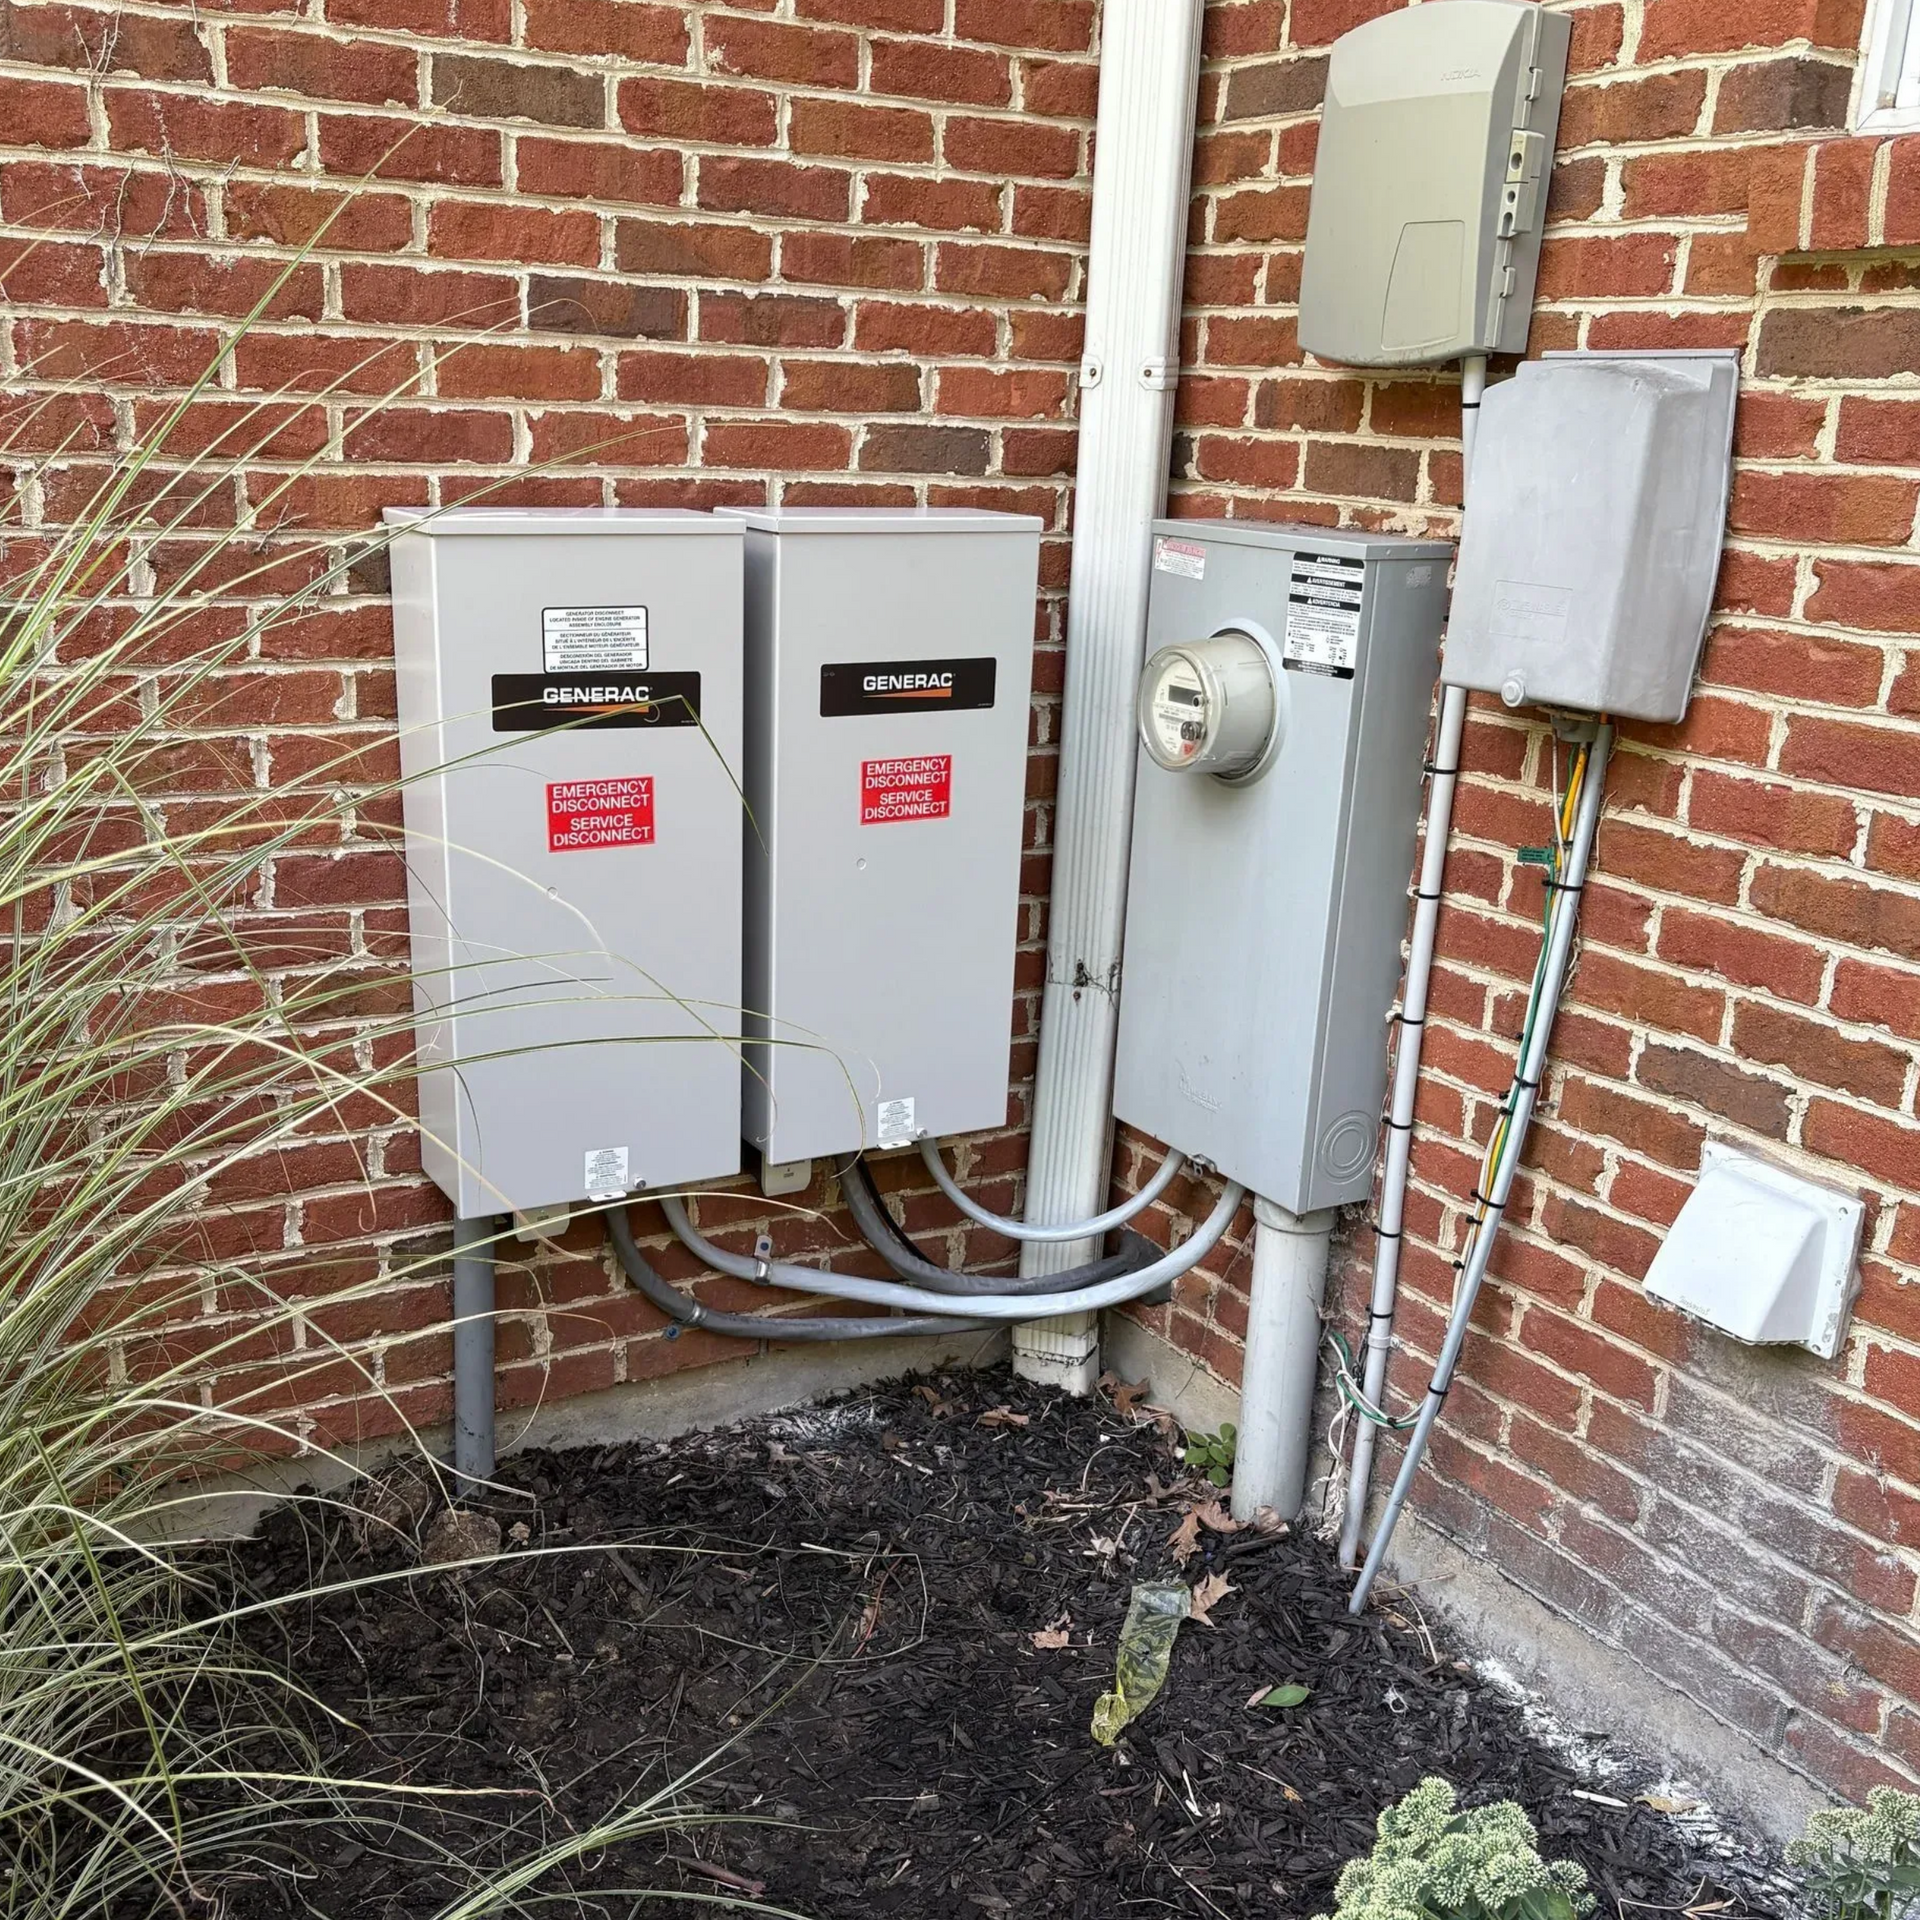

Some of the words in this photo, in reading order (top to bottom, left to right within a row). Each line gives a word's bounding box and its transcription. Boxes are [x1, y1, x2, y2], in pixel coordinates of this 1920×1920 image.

[863, 672, 953, 691] GENERAC
[543, 686, 649, 704] GENERAC
[867, 758, 947, 775] EMERGENCY
[866, 771, 948, 789] DISCONNECT
[553, 780, 648, 799] EMERGENCY
[880, 789, 933, 805] SERVICE
[552, 794, 650, 814] DISCONNECT
[865, 801, 947, 820] DISCONNECT
[571, 814, 634, 831] SERVICE
[553, 826, 651, 847] DISCONNECT
